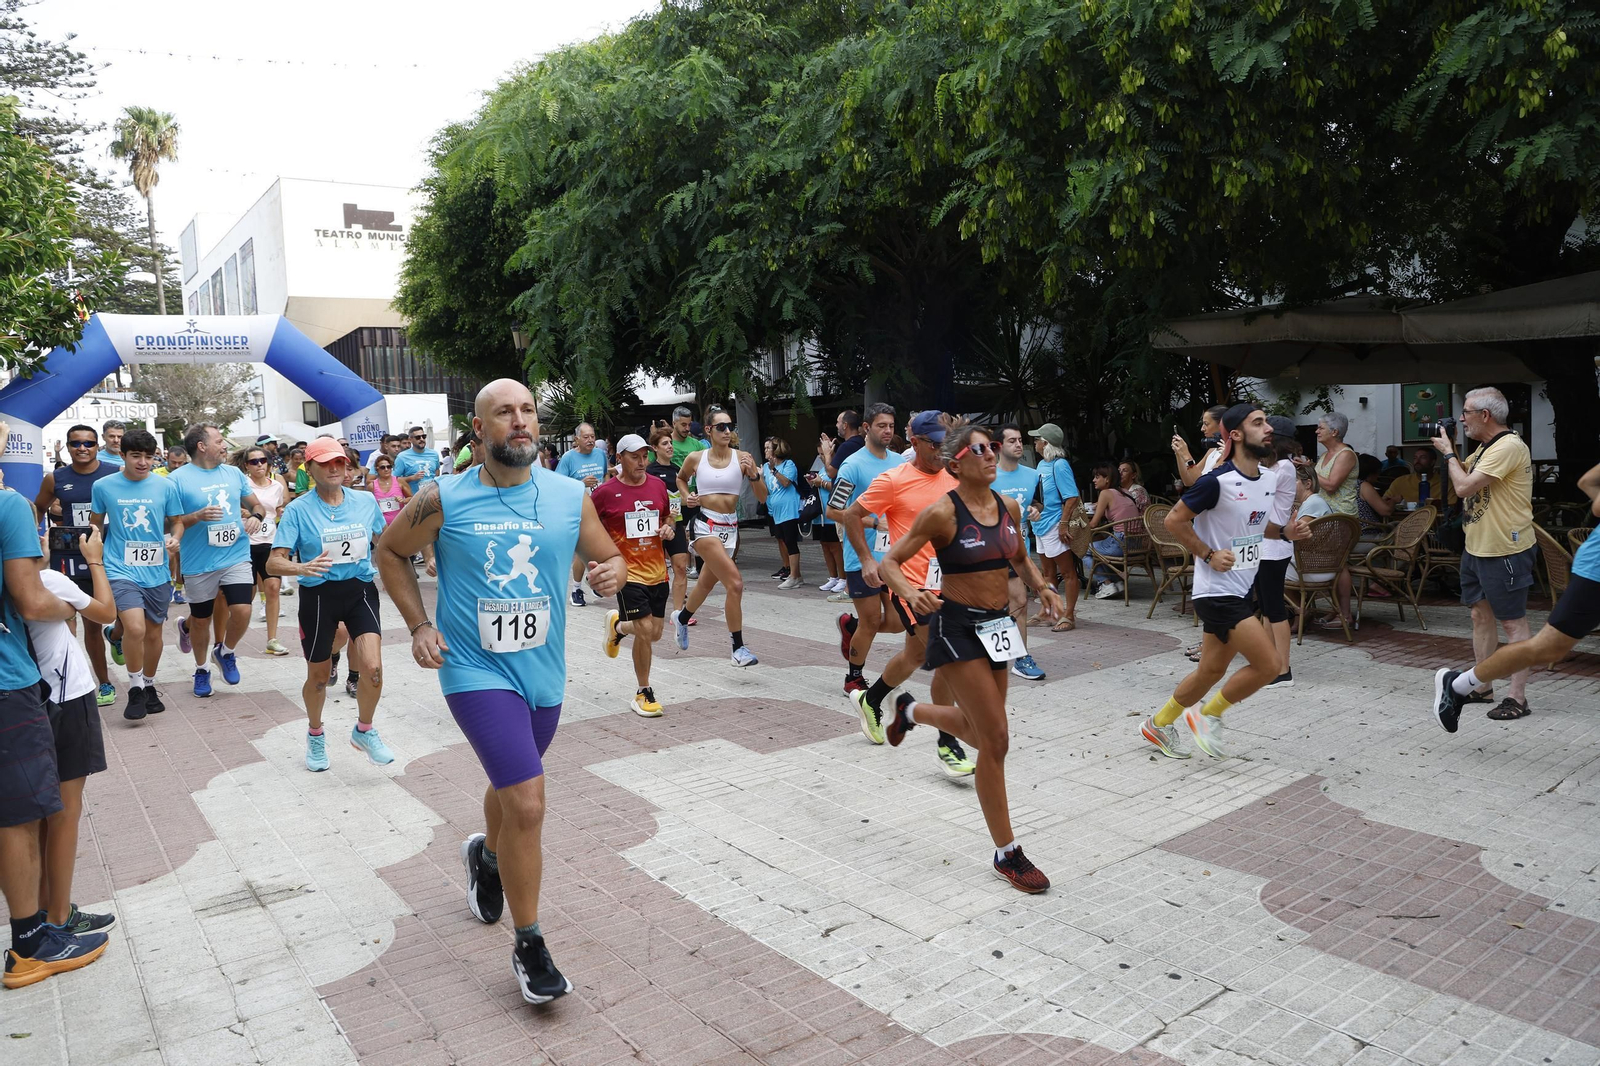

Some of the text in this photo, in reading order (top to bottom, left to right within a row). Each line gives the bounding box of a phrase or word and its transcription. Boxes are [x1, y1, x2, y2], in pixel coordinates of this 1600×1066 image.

[314, 229, 362, 240] TEATRO
[134, 335, 249, 350] CRONOFINISHER
[94, 405, 156, 419] TURISMO
[357, 424, 380, 433] CRONO
[474, 521, 545, 531] Desafío ELA
[637, 518, 650, 532] 61
[215, 529, 235, 543] 186
[132, 548, 157, 561] 187
[341, 541, 351, 556] 2
[1239, 544, 1260, 563] 150
[511, 601, 525, 613] ELA
[525, 601, 543, 610] TARIFA
[491, 613, 537, 641] 118
[991, 630, 1011, 652] 25
